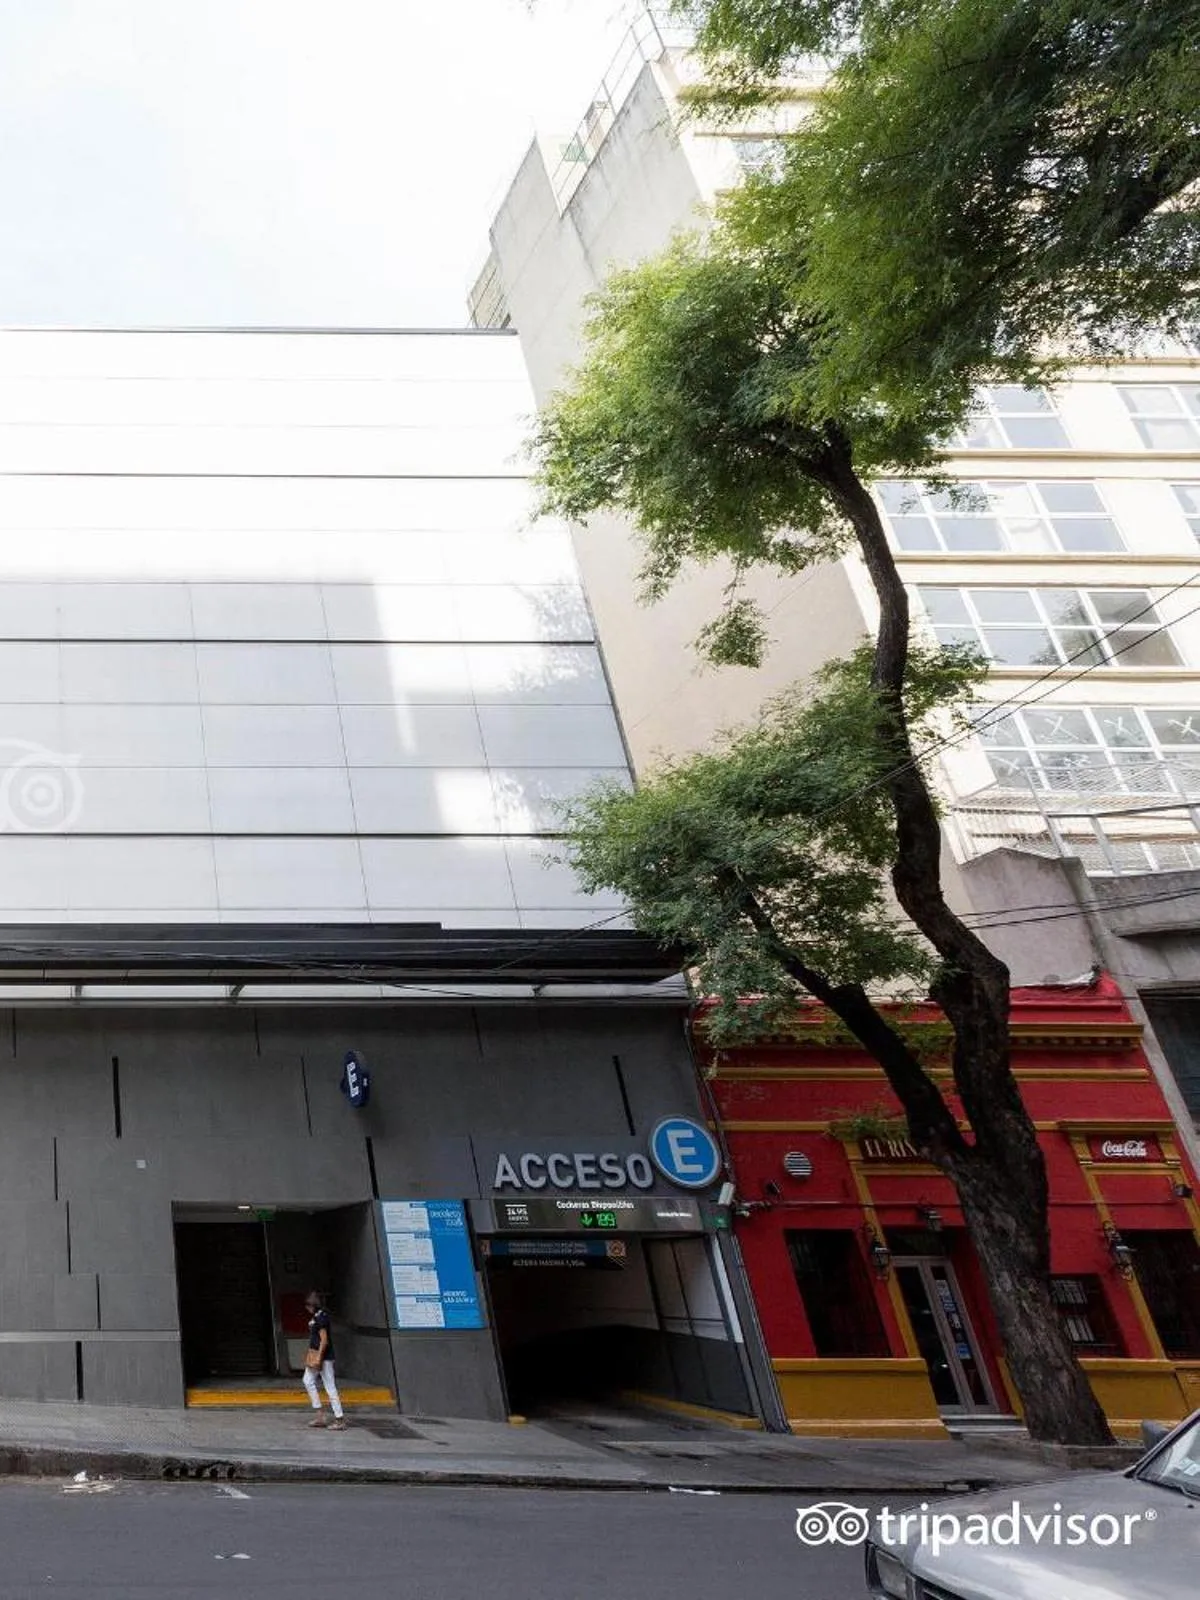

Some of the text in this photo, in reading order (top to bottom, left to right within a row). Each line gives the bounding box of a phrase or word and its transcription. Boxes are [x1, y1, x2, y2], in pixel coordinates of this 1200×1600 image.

[666, 1129, 703, 1174] E
[1102, 1140, 1147, 1157] Coca-Cola
[494, 1152, 654, 1189] ACCESO
[556, 1200, 634, 1210] Cocheras Disponibles
